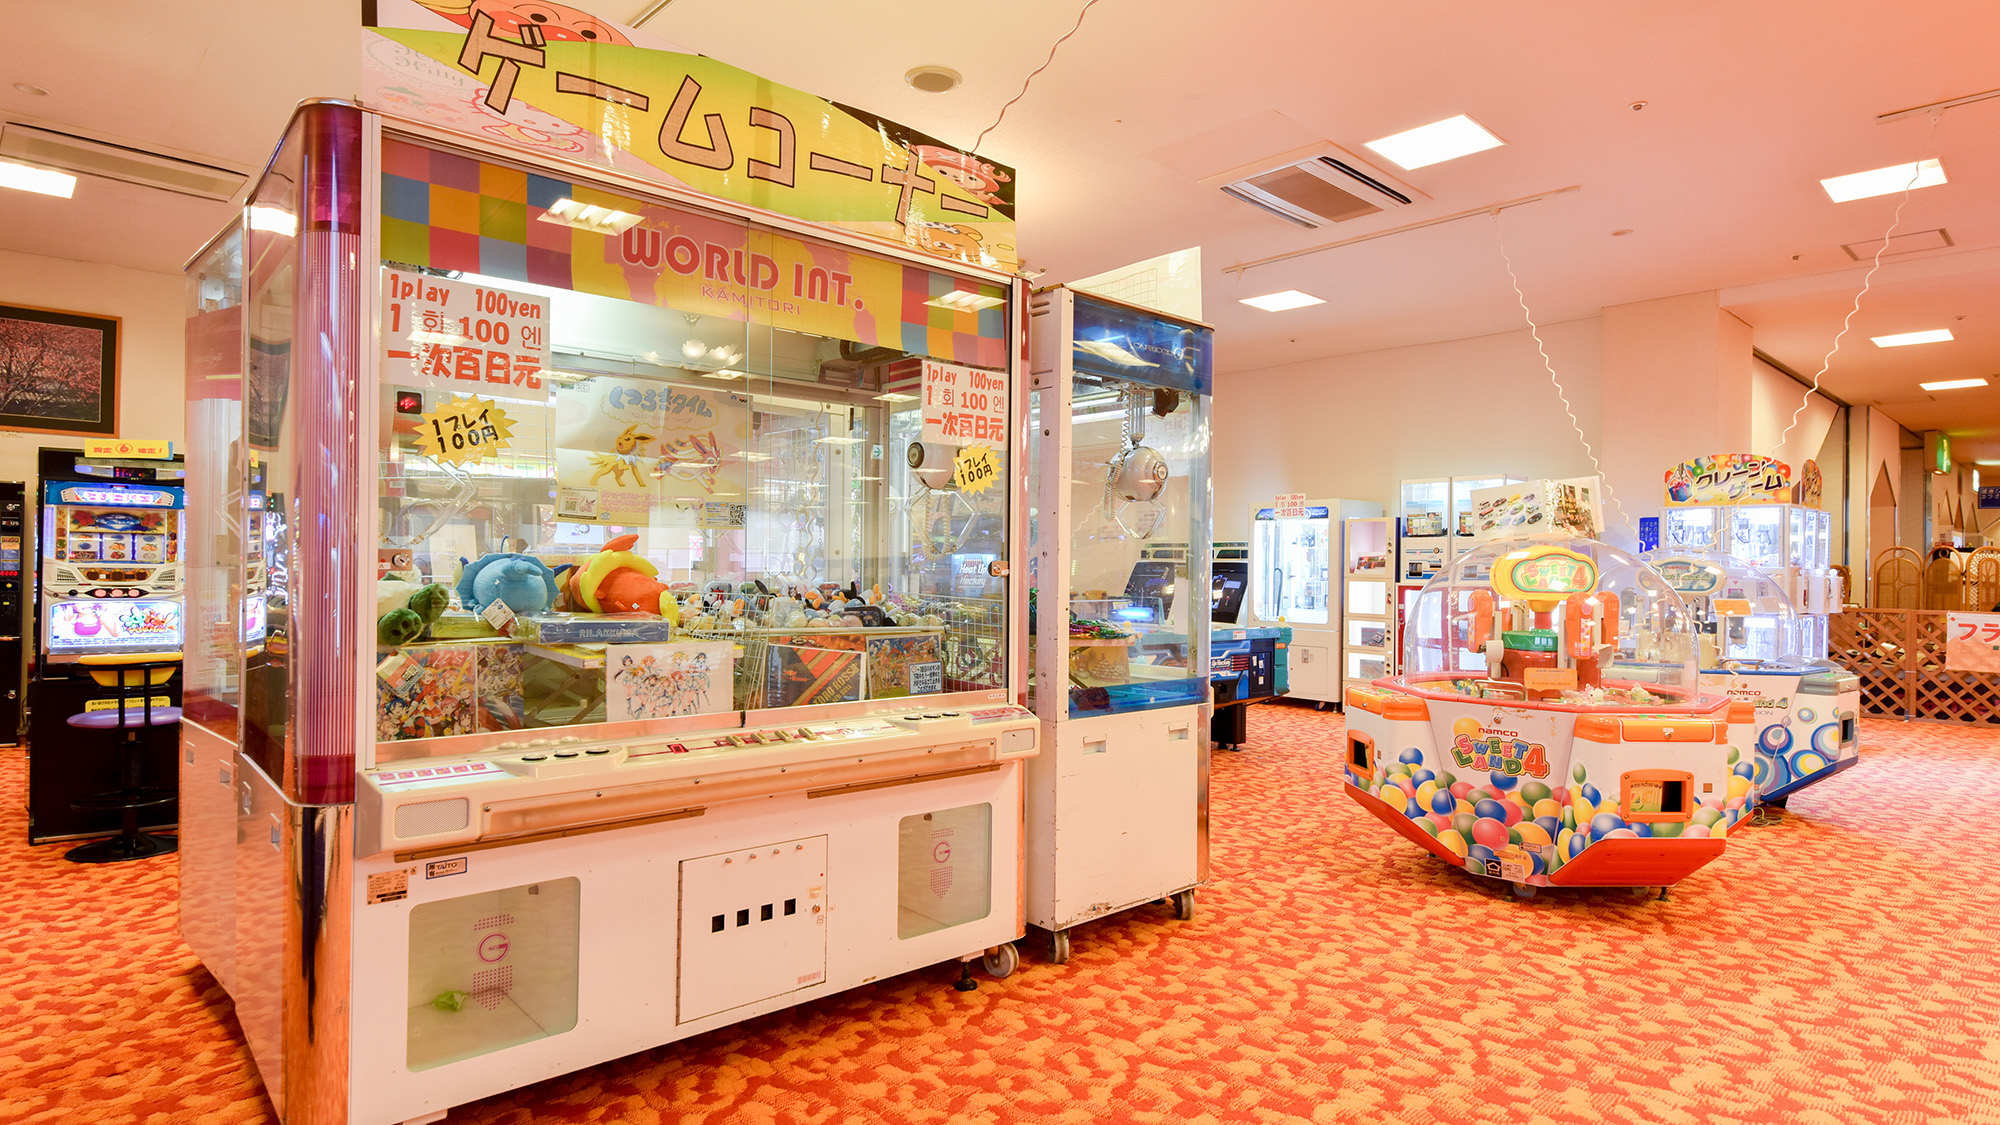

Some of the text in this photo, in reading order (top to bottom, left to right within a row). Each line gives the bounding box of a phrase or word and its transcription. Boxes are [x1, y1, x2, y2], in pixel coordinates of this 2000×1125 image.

[458, 10, 989, 226] ゲームコーナー
[621, 225, 865, 311] WORLD INT.
[390, 273, 541, 319] 1play 100yen
[702, 285, 800, 315] KAMITORI
[390, 303, 401, 333] 1
[458, 316, 510, 345] 100
[926, 363, 1004, 391] 1play 100yen
[926, 384, 933, 405] 1
[961, 391, 988, 411] 100
[959, 562, 988, 576] Heat Up
[1527, 562, 1576, 577] SWEET
[1572, 563, 1588, 588] 4
[578, 628, 640, 638] RILAKKUMA
[1775, 697, 1788, 709] 4
[1478, 727, 1519, 737] namco
[1452, 746, 1548, 777] LAND 4
[1456, 736, 1529, 760] SWEET
